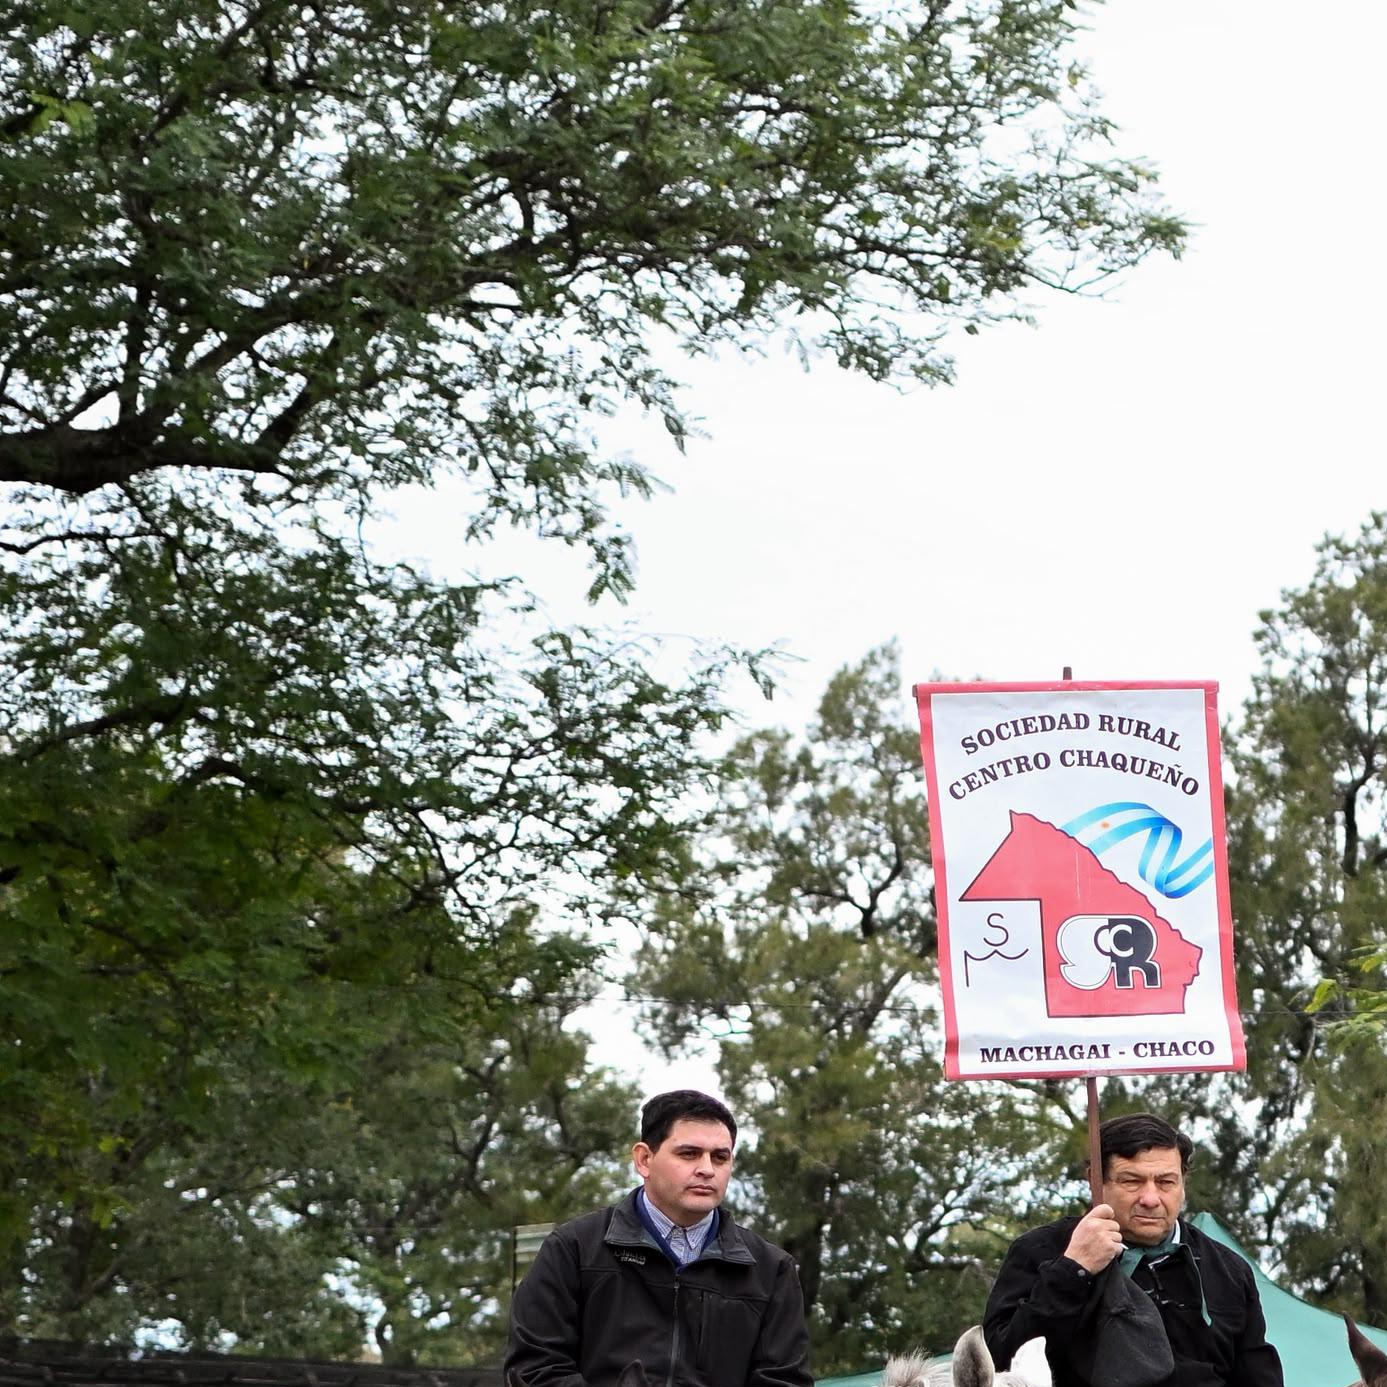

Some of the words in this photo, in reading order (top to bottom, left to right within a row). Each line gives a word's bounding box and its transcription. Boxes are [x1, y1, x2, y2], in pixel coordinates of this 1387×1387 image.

[961, 713, 1090, 755] SOCIEDAD
[1098, 714, 1182, 751] RURAL
[949, 752, 1051, 800] CENTRO
[1059, 749, 1199, 796] CHAQUEÑO
[980, 1044, 1111, 1063] MACHAGAI
[1133, 1040, 1215, 1058] CHACO
